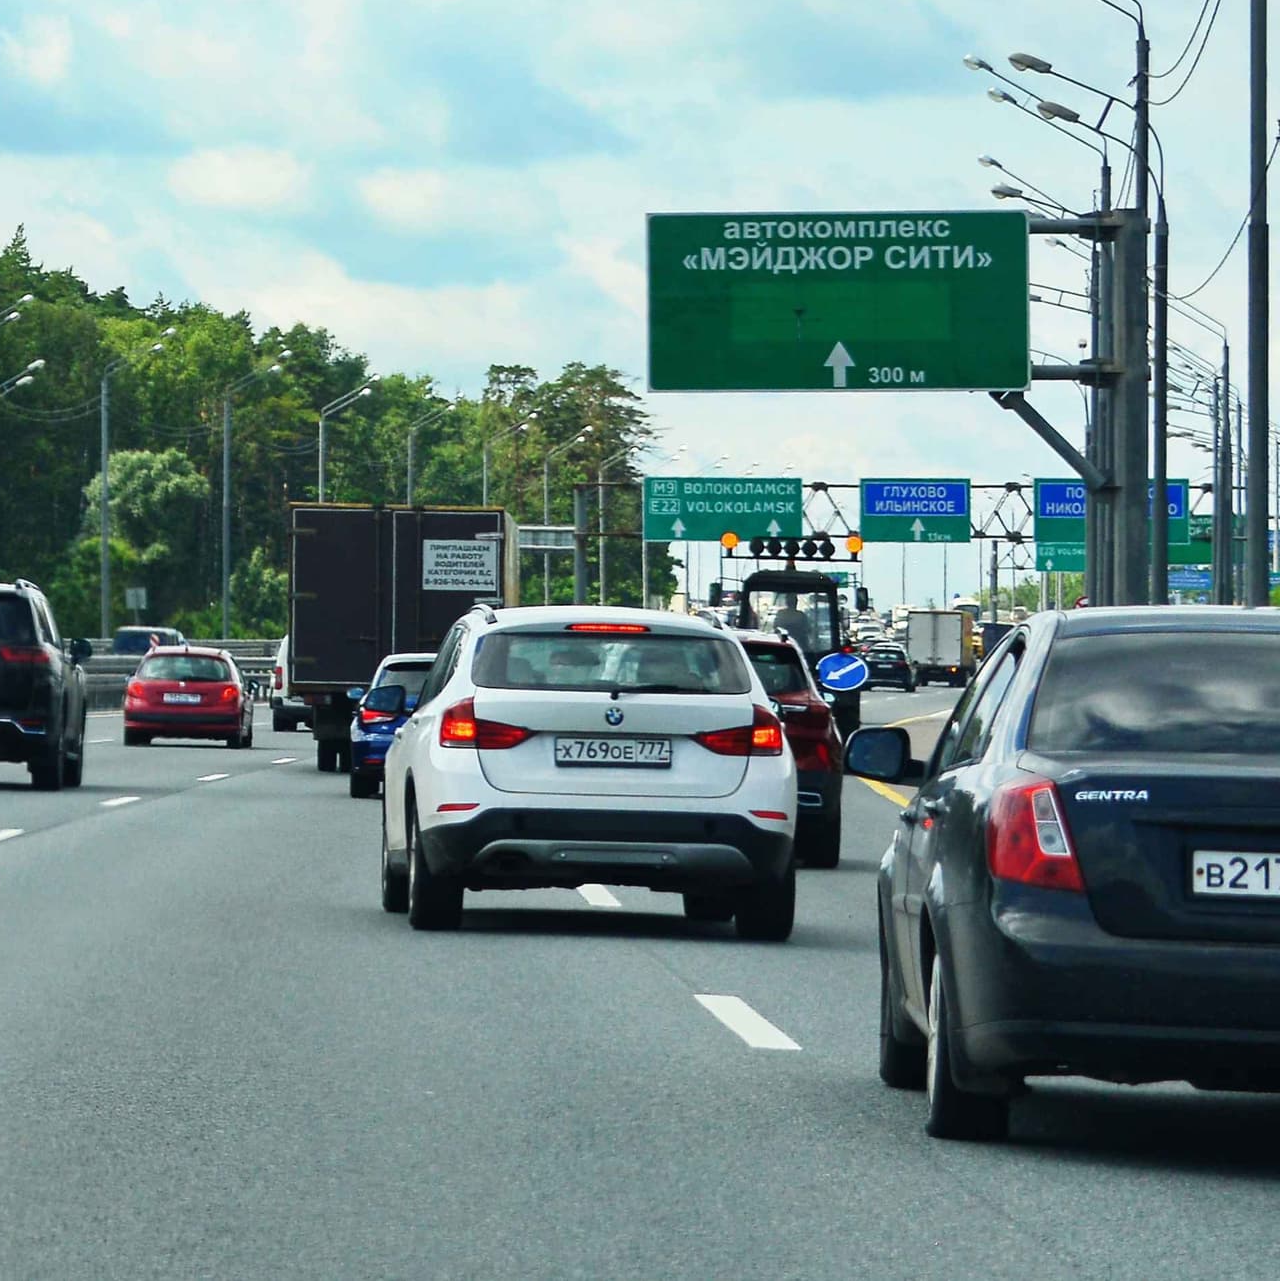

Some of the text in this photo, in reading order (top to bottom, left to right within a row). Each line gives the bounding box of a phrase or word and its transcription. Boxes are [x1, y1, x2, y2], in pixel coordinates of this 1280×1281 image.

[723, 218, 951, 240] автокомплекс
[682, 241, 993, 275] «МЭЙДЖОР СИТИ»
[868, 367, 926, 384] 300 м
[653, 482, 797, 496] М9 ВОЛОКОЛАМСК
[882, 486, 947, 498] ГЛУХОВО
[685, 500, 796, 514] VOLOKOLAMSK
[874, 500, 956, 513] ИЛЬИНСКОЕ
[429, 544, 491, 552] ПРИГЛАШАЕМ
[434, 560, 486, 568] ВОДИТЕЛЕЙ
[637, 741, 665, 755] 777
[1075, 789, 1150, 801] GENTRA
